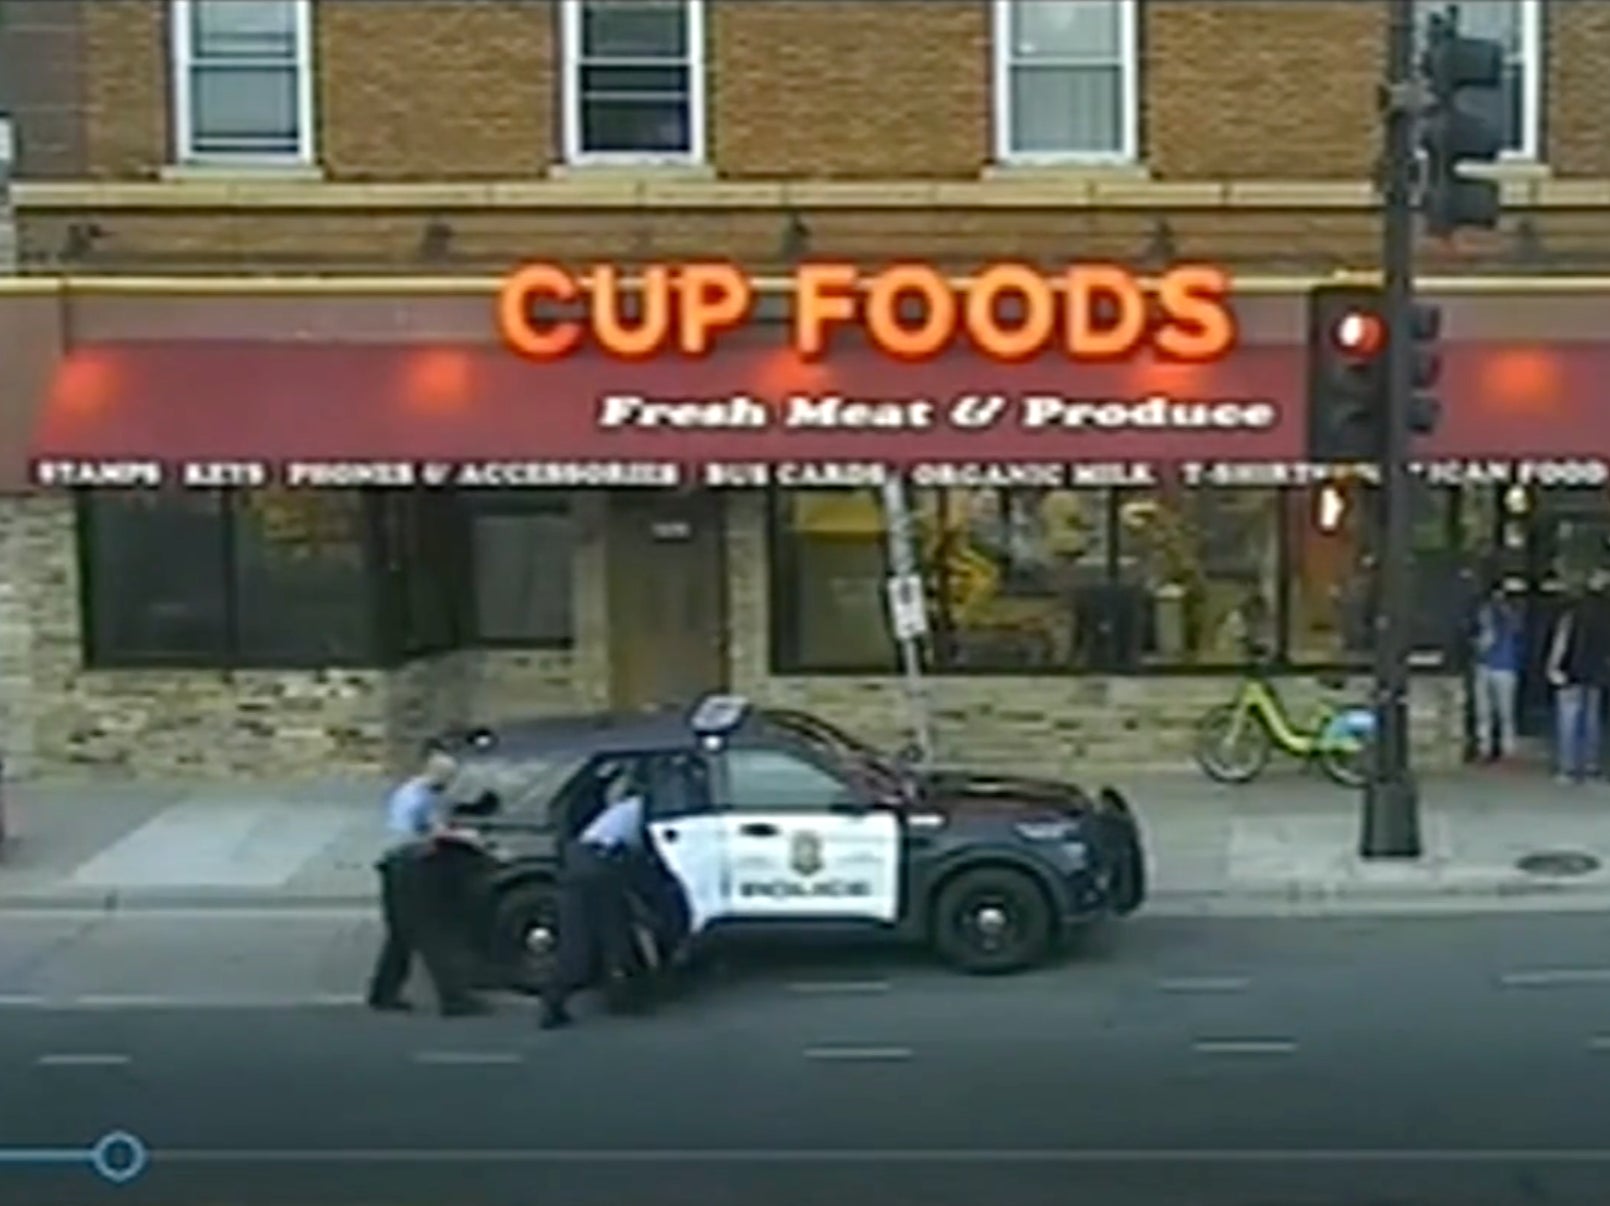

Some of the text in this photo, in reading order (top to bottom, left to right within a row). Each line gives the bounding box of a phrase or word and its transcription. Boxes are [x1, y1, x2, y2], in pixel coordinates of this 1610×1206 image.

[497, 262, 1236, 362] CUP FOODS
[598, 397, 1276, 428] Fresh Meat & Produce
[38, 463, 161, 486] STAMPS
[184, 463, 265, 486] KEYS
[287, 462, 414, 486] PHONES
[456, 462, 680, 486] ACCESSORIES
[705, 462, 768, 486] BUS
[774, 462, 885, 486] CARDS
[911, 462, 1065, 486] ORGANIC
[1072, 462, 1157, 486] MILK
[1517, 462, 1608, 486] FOOD
[740, 880, 872, 898] POLICE
